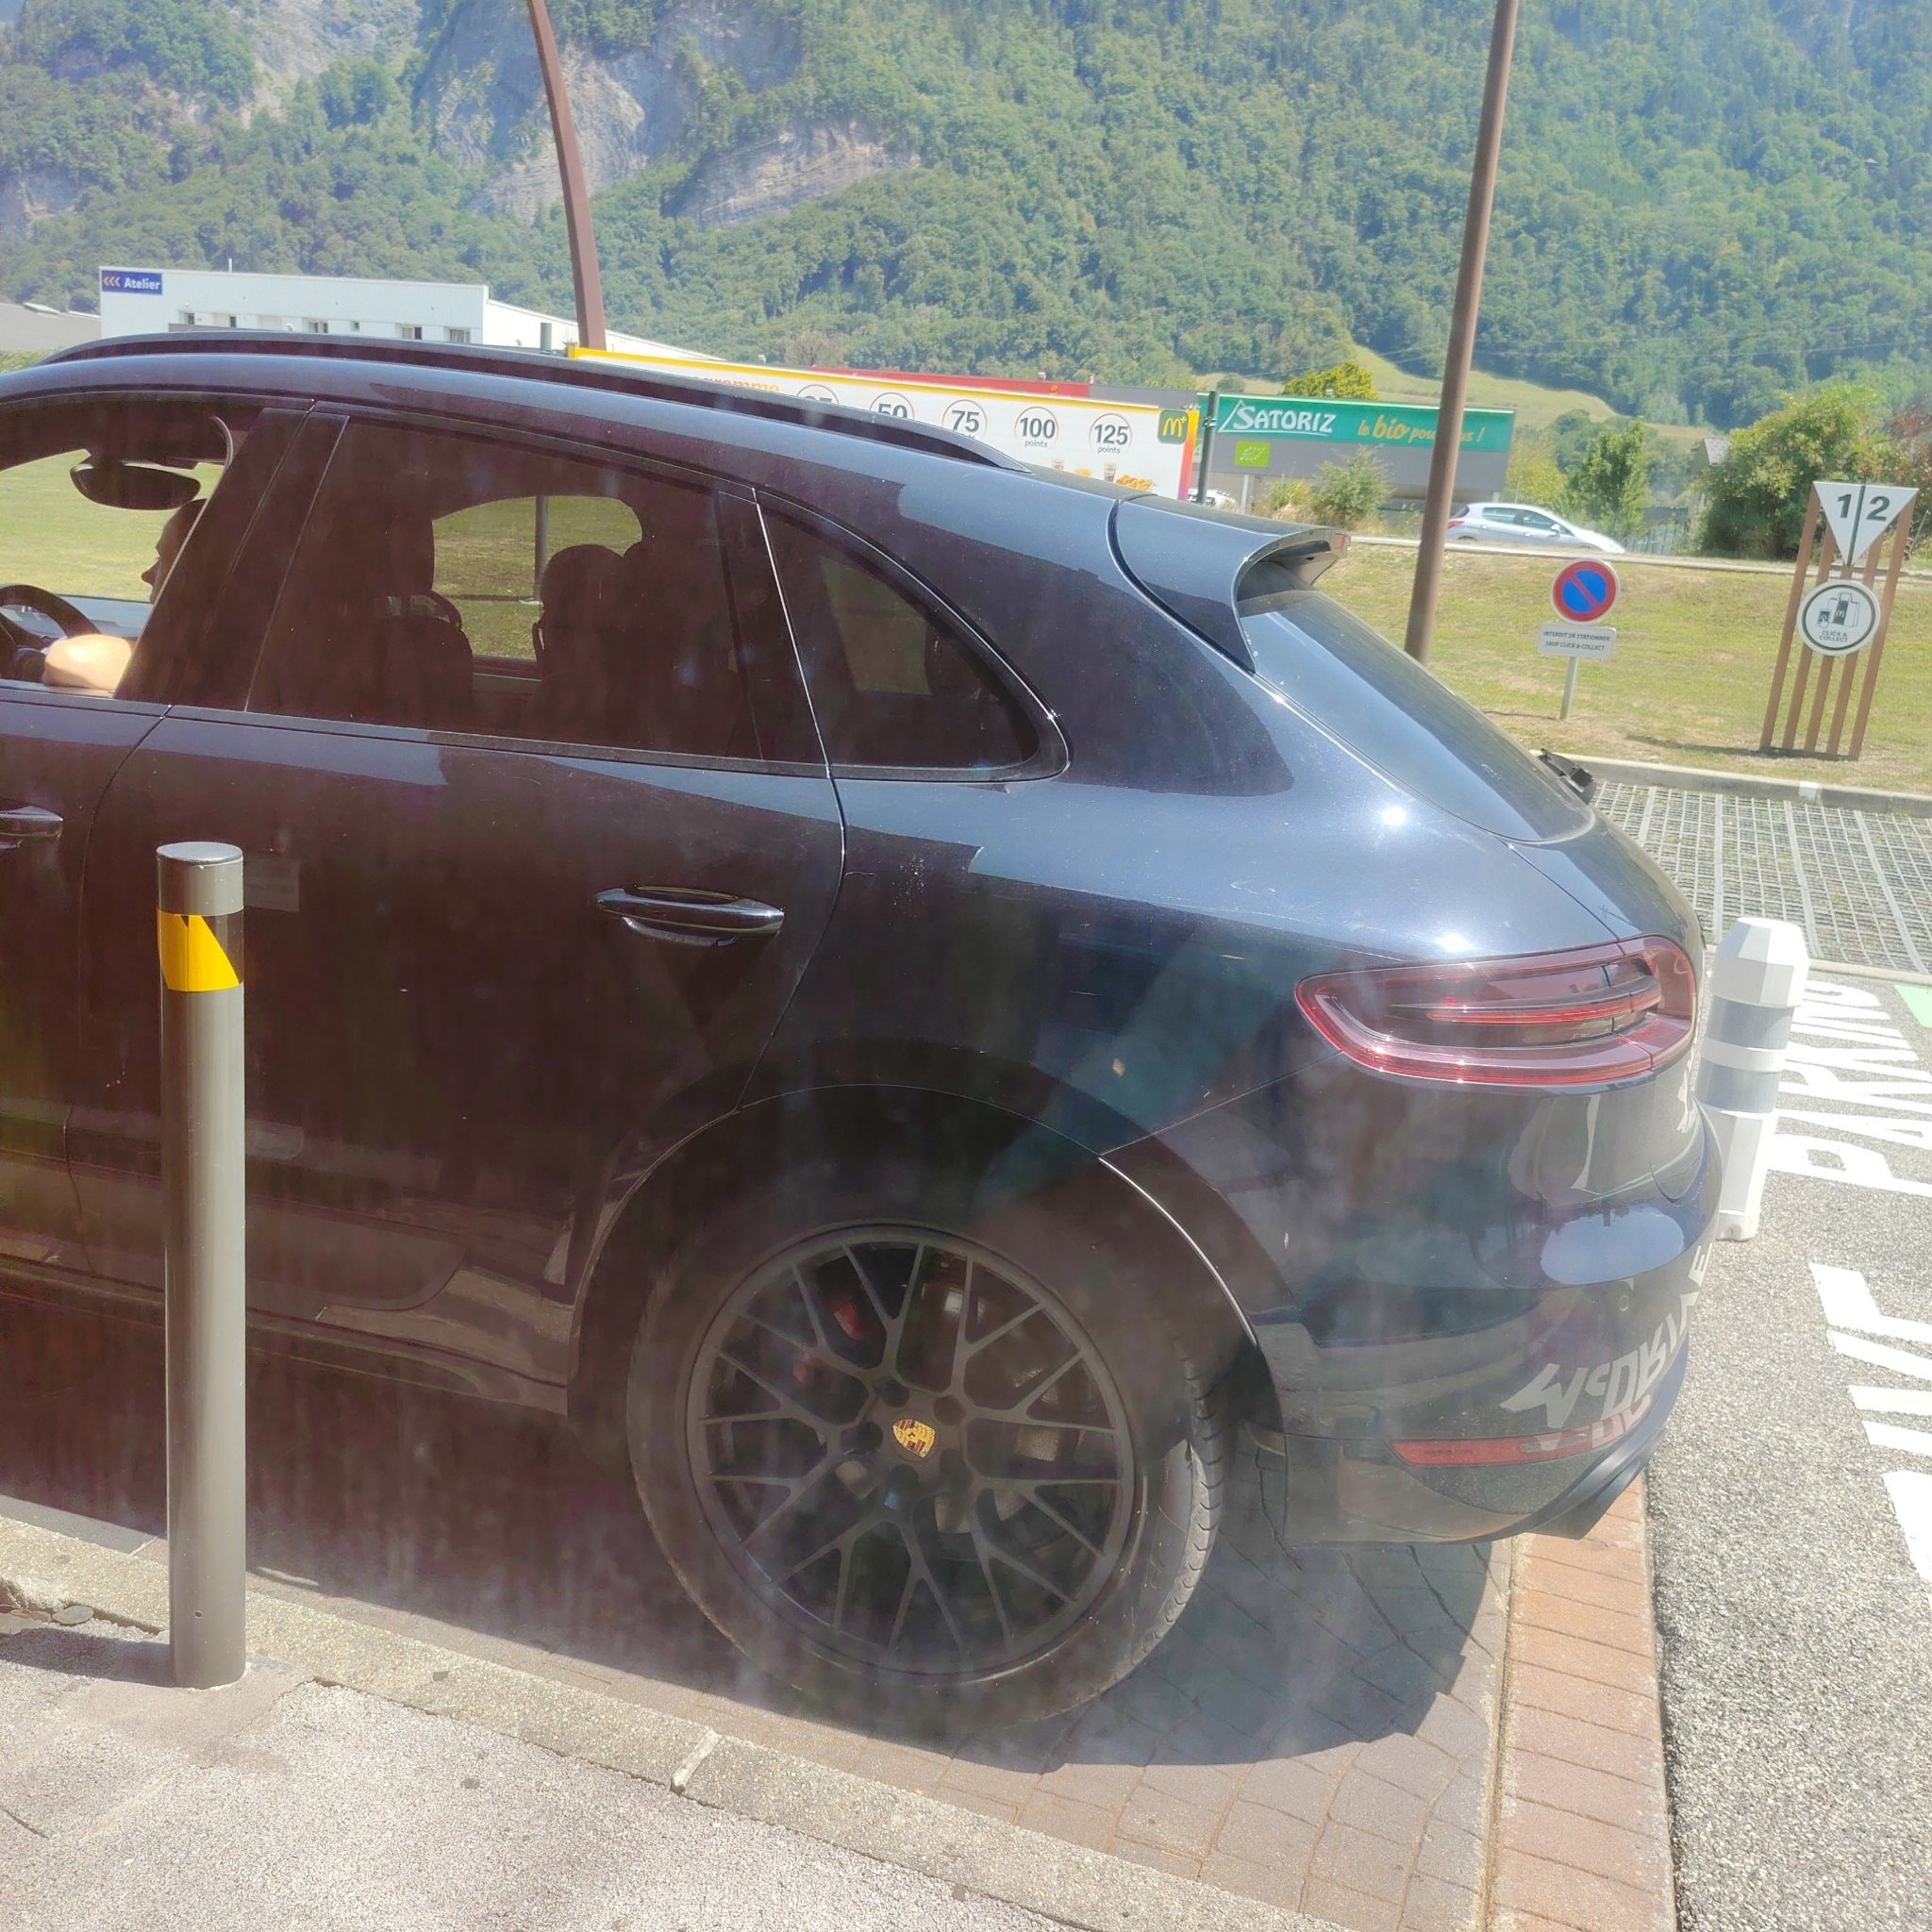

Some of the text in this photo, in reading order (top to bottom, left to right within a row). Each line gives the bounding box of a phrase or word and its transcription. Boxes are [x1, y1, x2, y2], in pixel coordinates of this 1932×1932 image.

[124, 276, 160, 291] Atelier
[951, 409, 980, 433] 75
[1019, 417, 1056, 440] 100
[1233, 406, 1337, 434] SATORIZ
[1372, 414, 1410, 440] bio
[1407, 426, 1437, 443] pou
[1024, 439, 1049, 449] points
[1093, 424, 1128, 446] 125
[1097, 445, 1121, 455] points
[1837, 493, 1890, 522] 1 2
